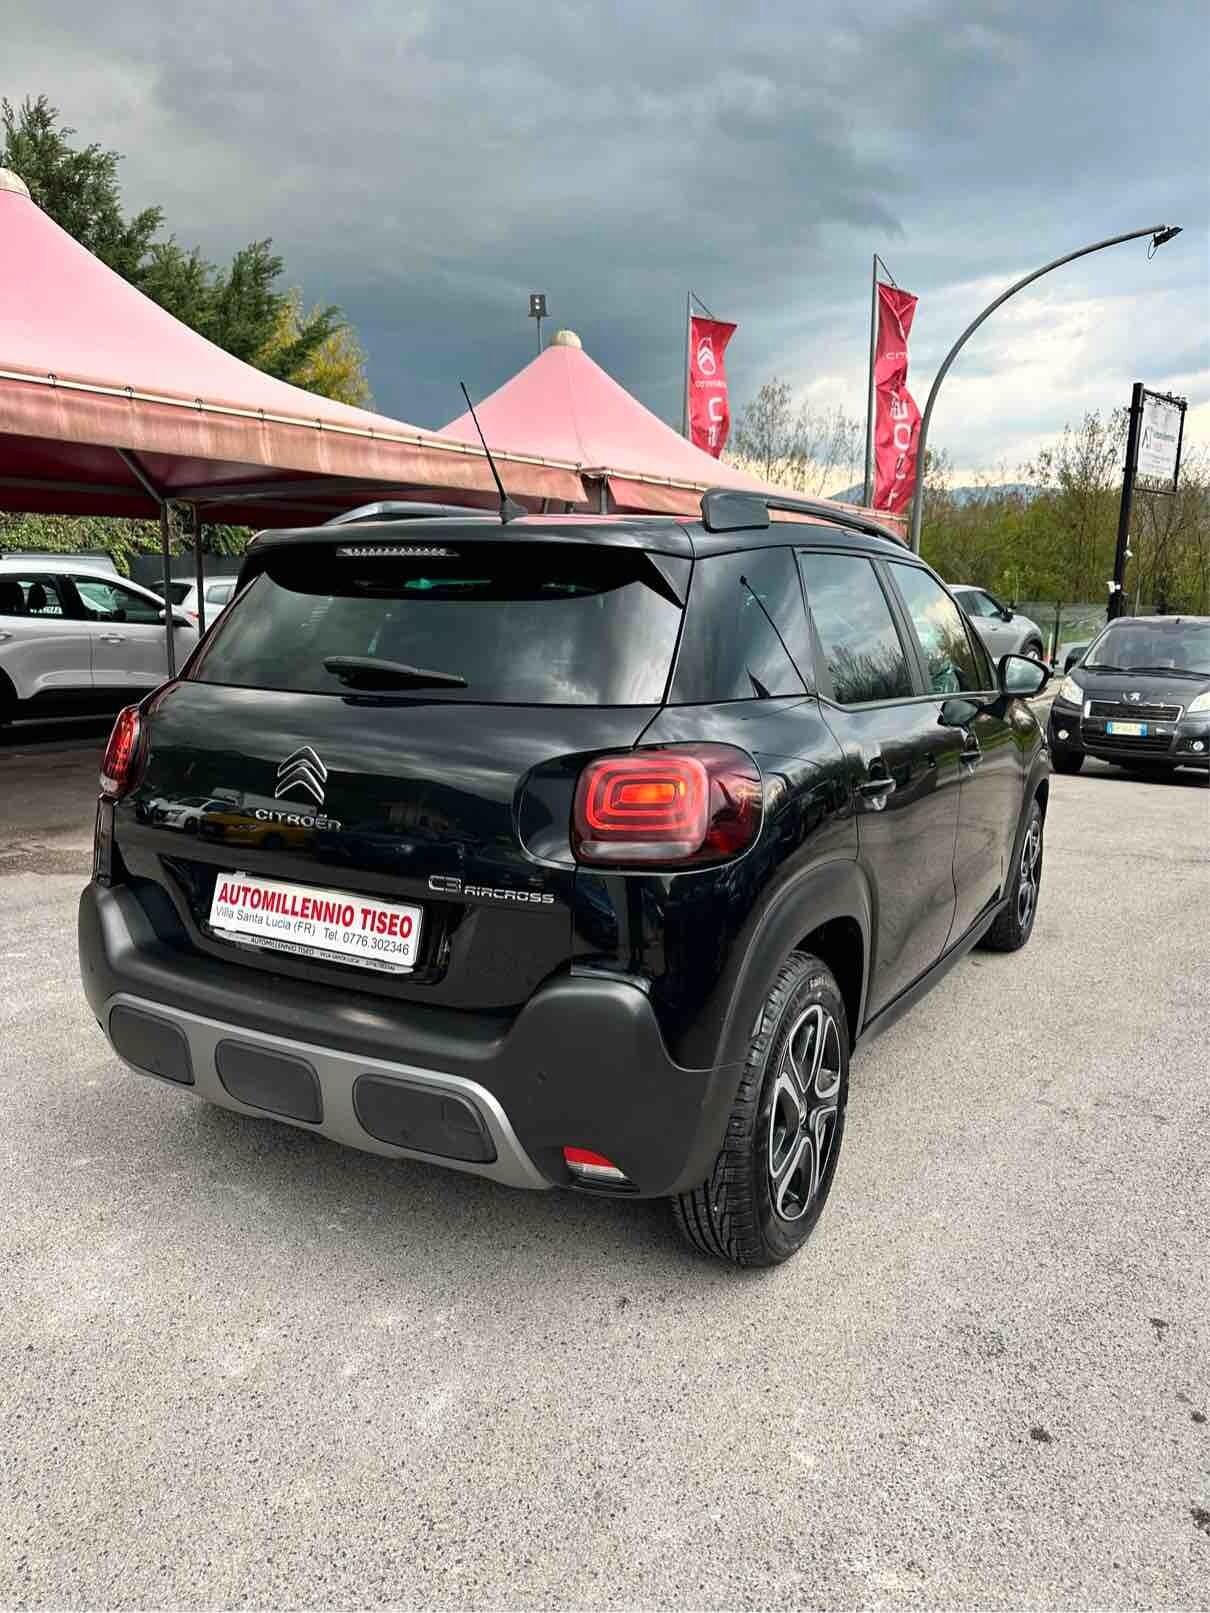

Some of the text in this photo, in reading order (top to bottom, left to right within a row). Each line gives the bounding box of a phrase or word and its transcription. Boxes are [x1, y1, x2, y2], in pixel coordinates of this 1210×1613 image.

[218, 882, 413, 938] AUTOMILLENNIO TISEO
[428, 875, 555, 904] C3 AIRCROSS
[216, 905, 235, 918] Villa
[236, 909, 264, 925] Santa
[266, 914, 291, 930] Lucia
[293, 919, 316, 937] (FR)
[342, 931, 410, 956] 0776.302346
